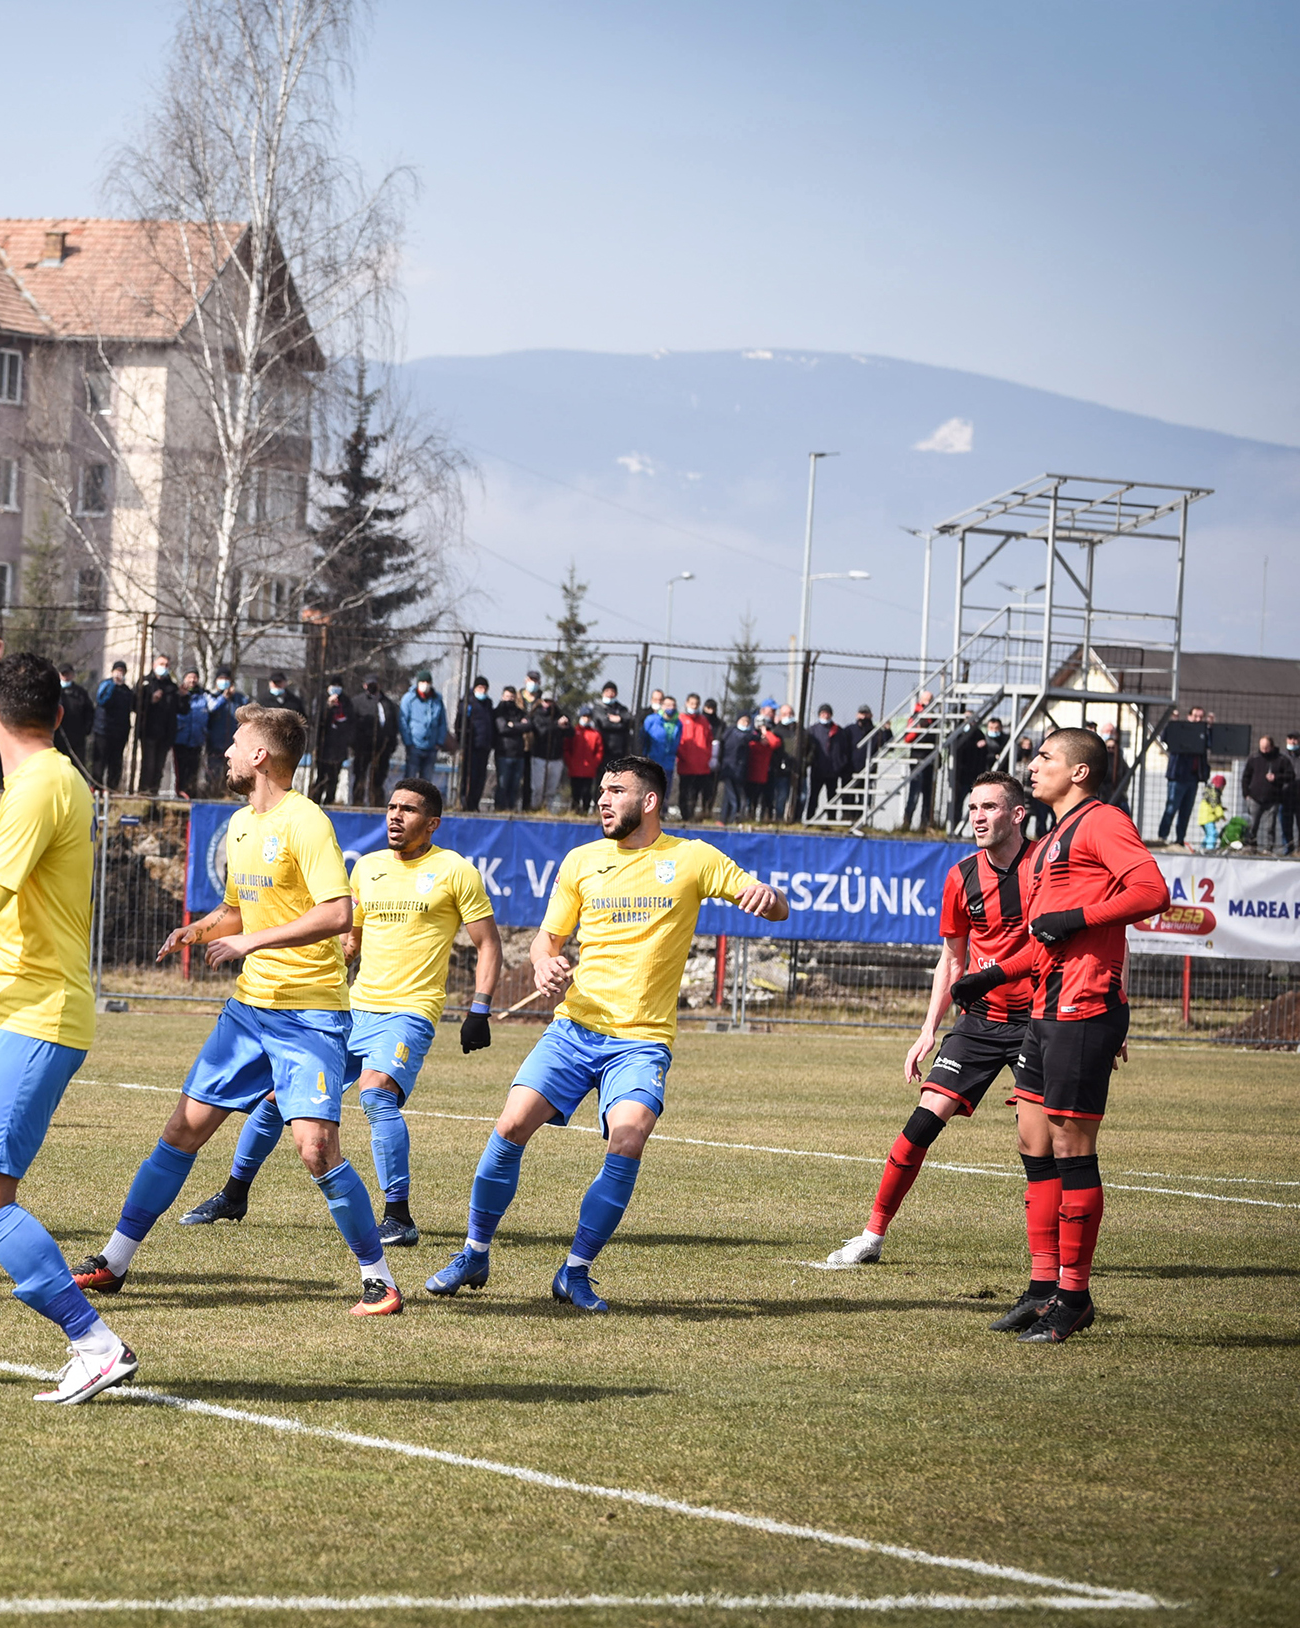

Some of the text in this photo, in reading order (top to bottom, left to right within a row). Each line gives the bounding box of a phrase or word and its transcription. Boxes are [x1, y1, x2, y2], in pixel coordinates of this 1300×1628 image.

[1198, 877, 1215, 903] 2
[592, 896, 673, 911] CONSILIUL JUDEȚEAN
[1229, 899, 1290, 919] MAREA
[1161, 906, 1205, 924] casa
[1160, 921, 1201, 931] pariurilor
[317, 1071, 327, 1094] 4
